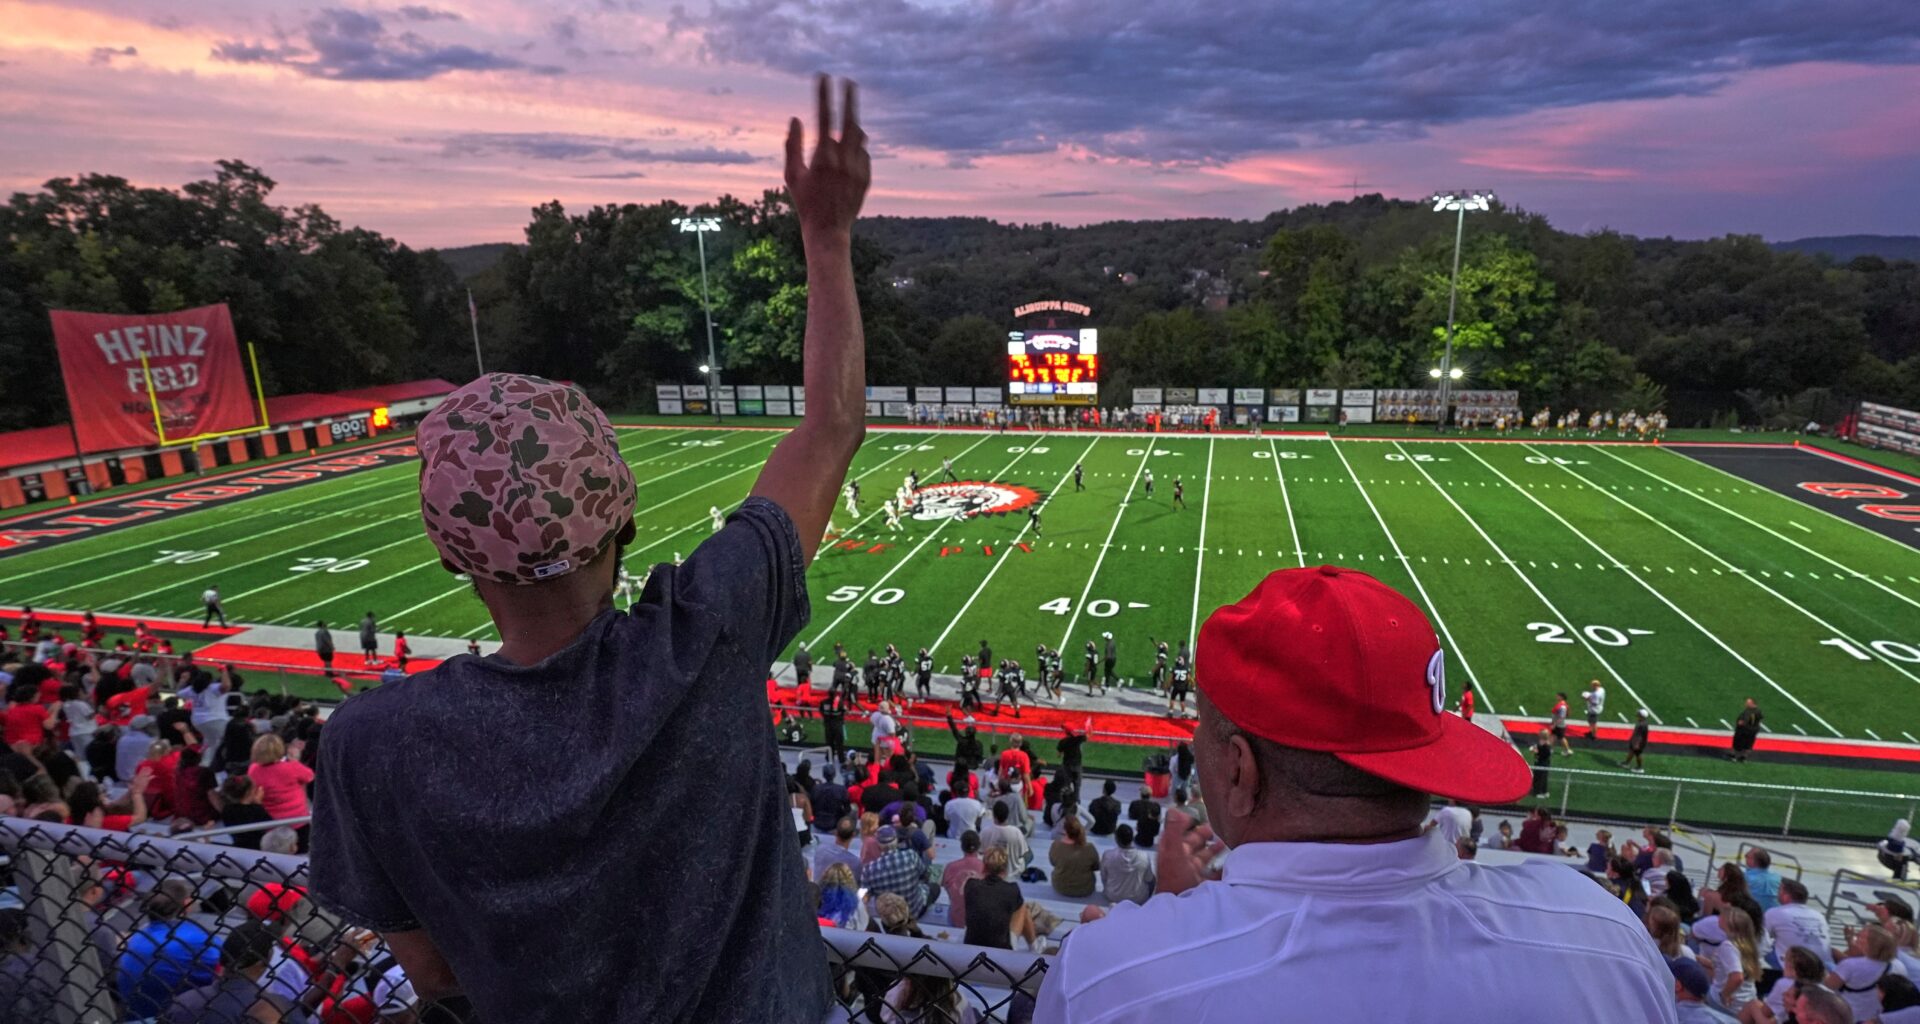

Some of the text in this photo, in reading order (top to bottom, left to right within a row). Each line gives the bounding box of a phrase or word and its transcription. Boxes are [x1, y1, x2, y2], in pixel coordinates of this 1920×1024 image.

[94, 324, 208, 365] HEINZ
[126, 361, 199, 393] FELD
[331, 419, 360, 435] 800
[0, 445, 418, 550] ALIQUIPP
[152, 550, 221, 564] 10
[288, 557, 371, 573] 20
[826, 585, 905, 605] 50
[1038, 597, 1121, 617] 40
[1526, 622, 1630, 647] 20
[1819, 638, 1920, 663] 10
[1174, 669, 1187, 681] 75
